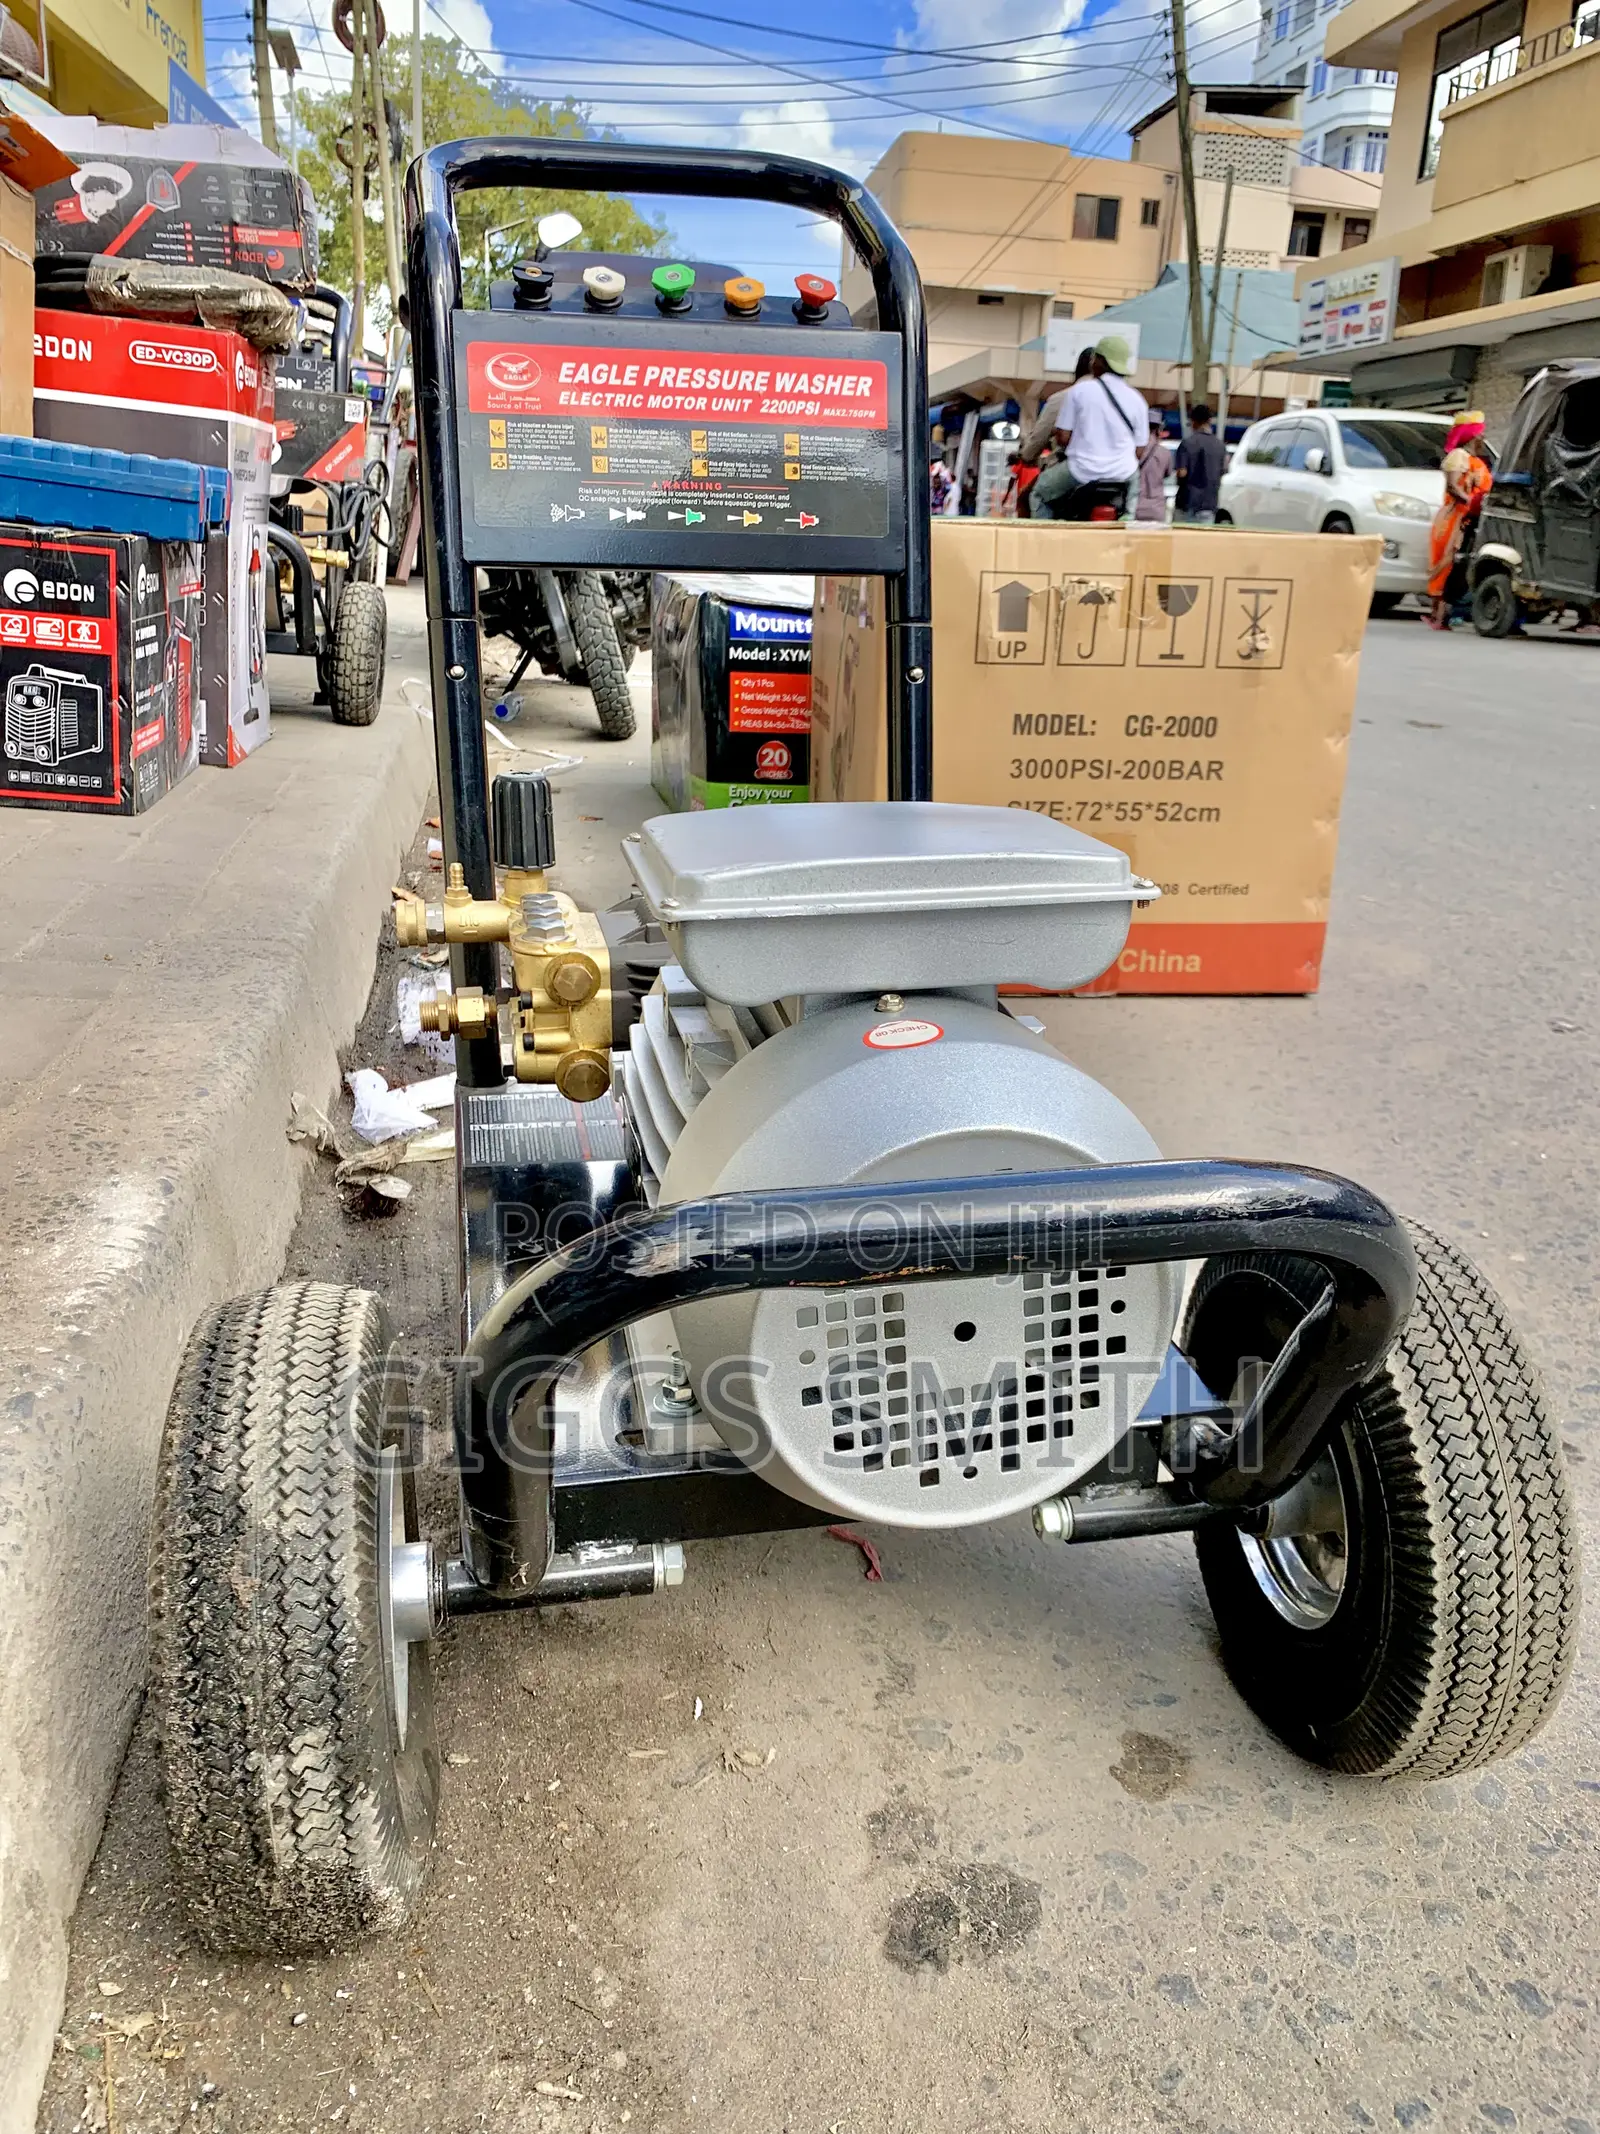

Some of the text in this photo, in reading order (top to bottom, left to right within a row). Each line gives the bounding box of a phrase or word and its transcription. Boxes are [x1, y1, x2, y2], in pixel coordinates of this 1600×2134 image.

[135, 347, 212, 367] ED-VC30P
[558, 362, 873, 397] EAGLE PRESSURE WASHER
[487, 401, 511, 409] Source
[524, 402, 541, 410] Trust
[559, 392, 876, 418] ELECTRIC MOTOR UNIT 2200PSI MAX2.75GPM
[661, 480, 722, 490] WARNING
[998, 640, 1027, 659] UP
[1012, 713, 1218, 738] MODEL: CG-2000
[761, 748, 788, 767] 20
[1009, 758, 1224, 781] 3000PSI-200BAR
[729, 785, 793, 800] Enjoy your
[1188, 883, 1250, 896] Certified
[1117, 949, 1201, 973] China
[890, 1025, 928, 1034] CHECK
